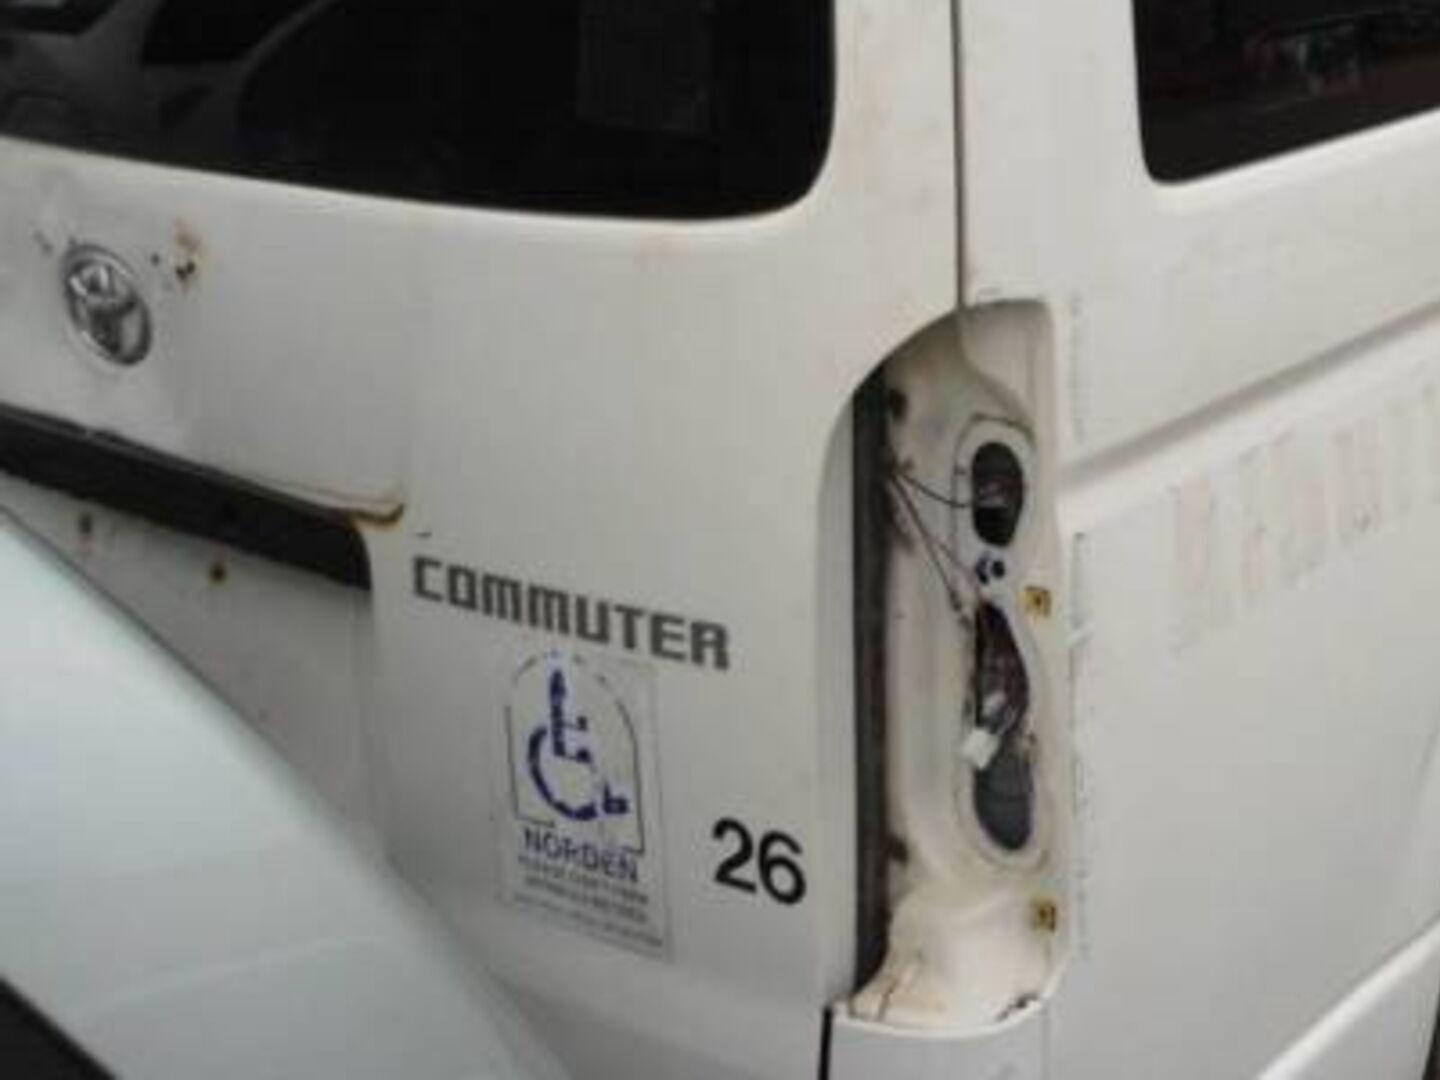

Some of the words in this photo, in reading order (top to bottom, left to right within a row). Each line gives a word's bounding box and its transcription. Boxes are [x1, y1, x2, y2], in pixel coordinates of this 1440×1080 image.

[411, 554, 731, 671] COMMUTER
[522, 826, 641, 884] NORDEN
[711, 816, 808, 906] 26
